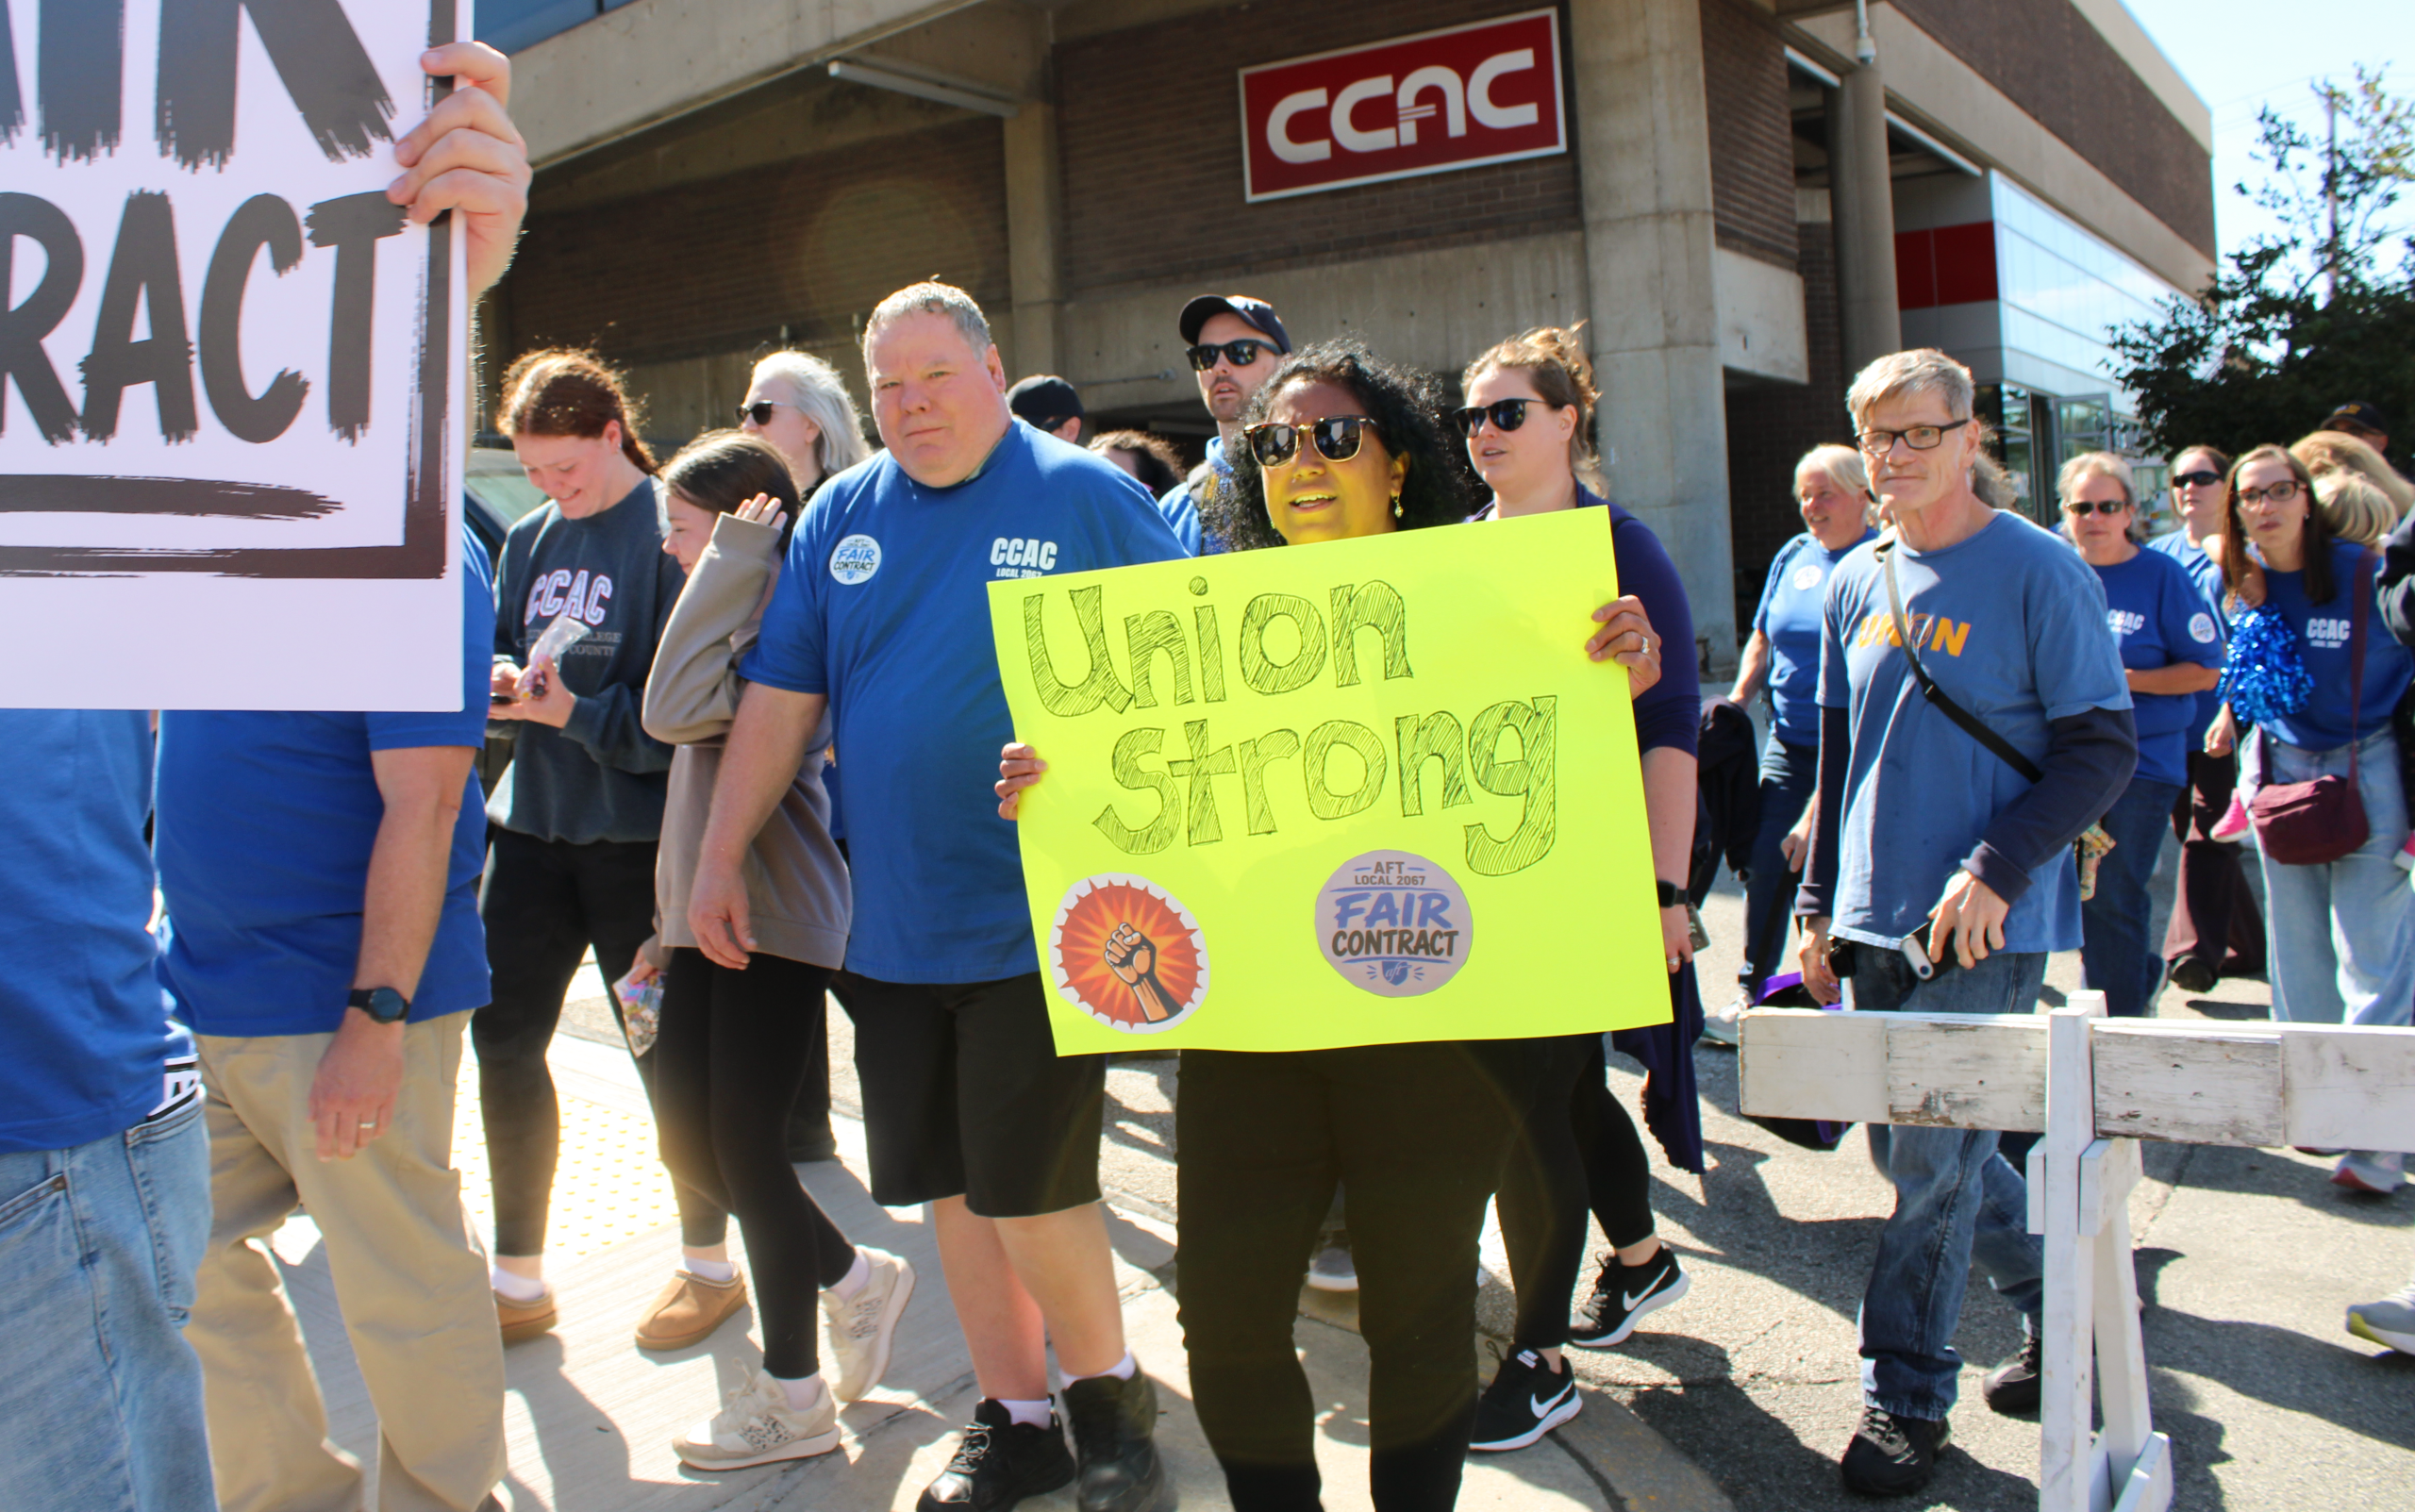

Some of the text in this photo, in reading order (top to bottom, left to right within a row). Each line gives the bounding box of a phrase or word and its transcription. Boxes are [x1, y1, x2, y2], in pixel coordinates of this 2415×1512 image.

[1267, 47, 1539, 164] CCAC
[834, 561, 875, 572] CONTRACT
[838, 548, 875, 562] FAIR
[990, 537, 1058, 571] CCAC
[996, 567, 1019, 578] LOCAL
[524, 569, 613, 626] CCAC
[2306, 618, 2351, 641] CCAC
[1024, 576, 1413, 717] Union
[1355, 874, 1426, 886] LOCAL 2067
[1374, 861, 1405, 874] AFT
[1333, 891, 1454, 929] FAIR
[1331, 929, 1460, 957] CONTRACT
